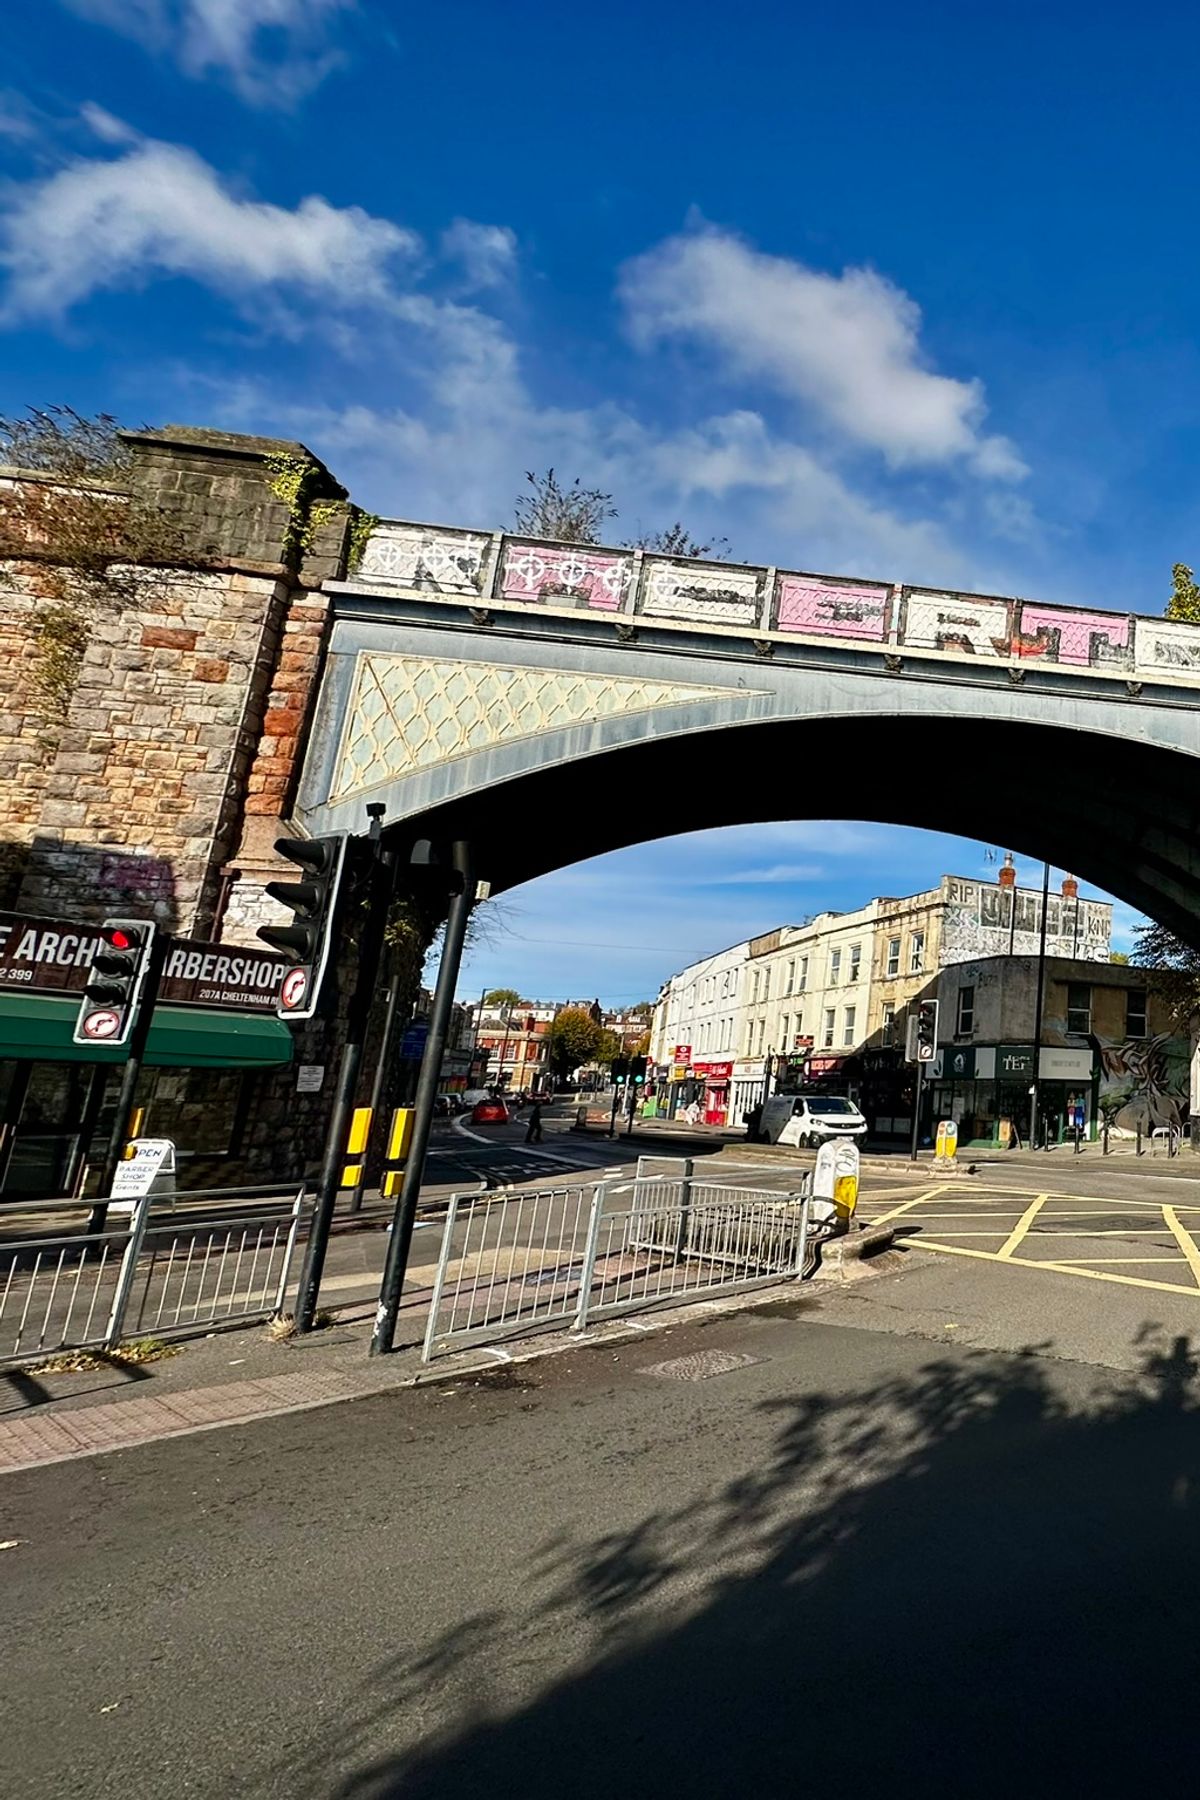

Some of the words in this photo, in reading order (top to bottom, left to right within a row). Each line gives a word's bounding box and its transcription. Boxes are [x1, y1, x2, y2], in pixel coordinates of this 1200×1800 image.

[949, 883, 974, 903] RIP
[12, 929, 98, 968] ARCH
[162, 949, 284, 989] RBERSHOP
[8, 968, 33, 981] 399
[199, 988, 220, 1000] 207A
[221, 990, 270, 1005] CHELTENHAM
[139, 1148, 161, 1157] PEN
